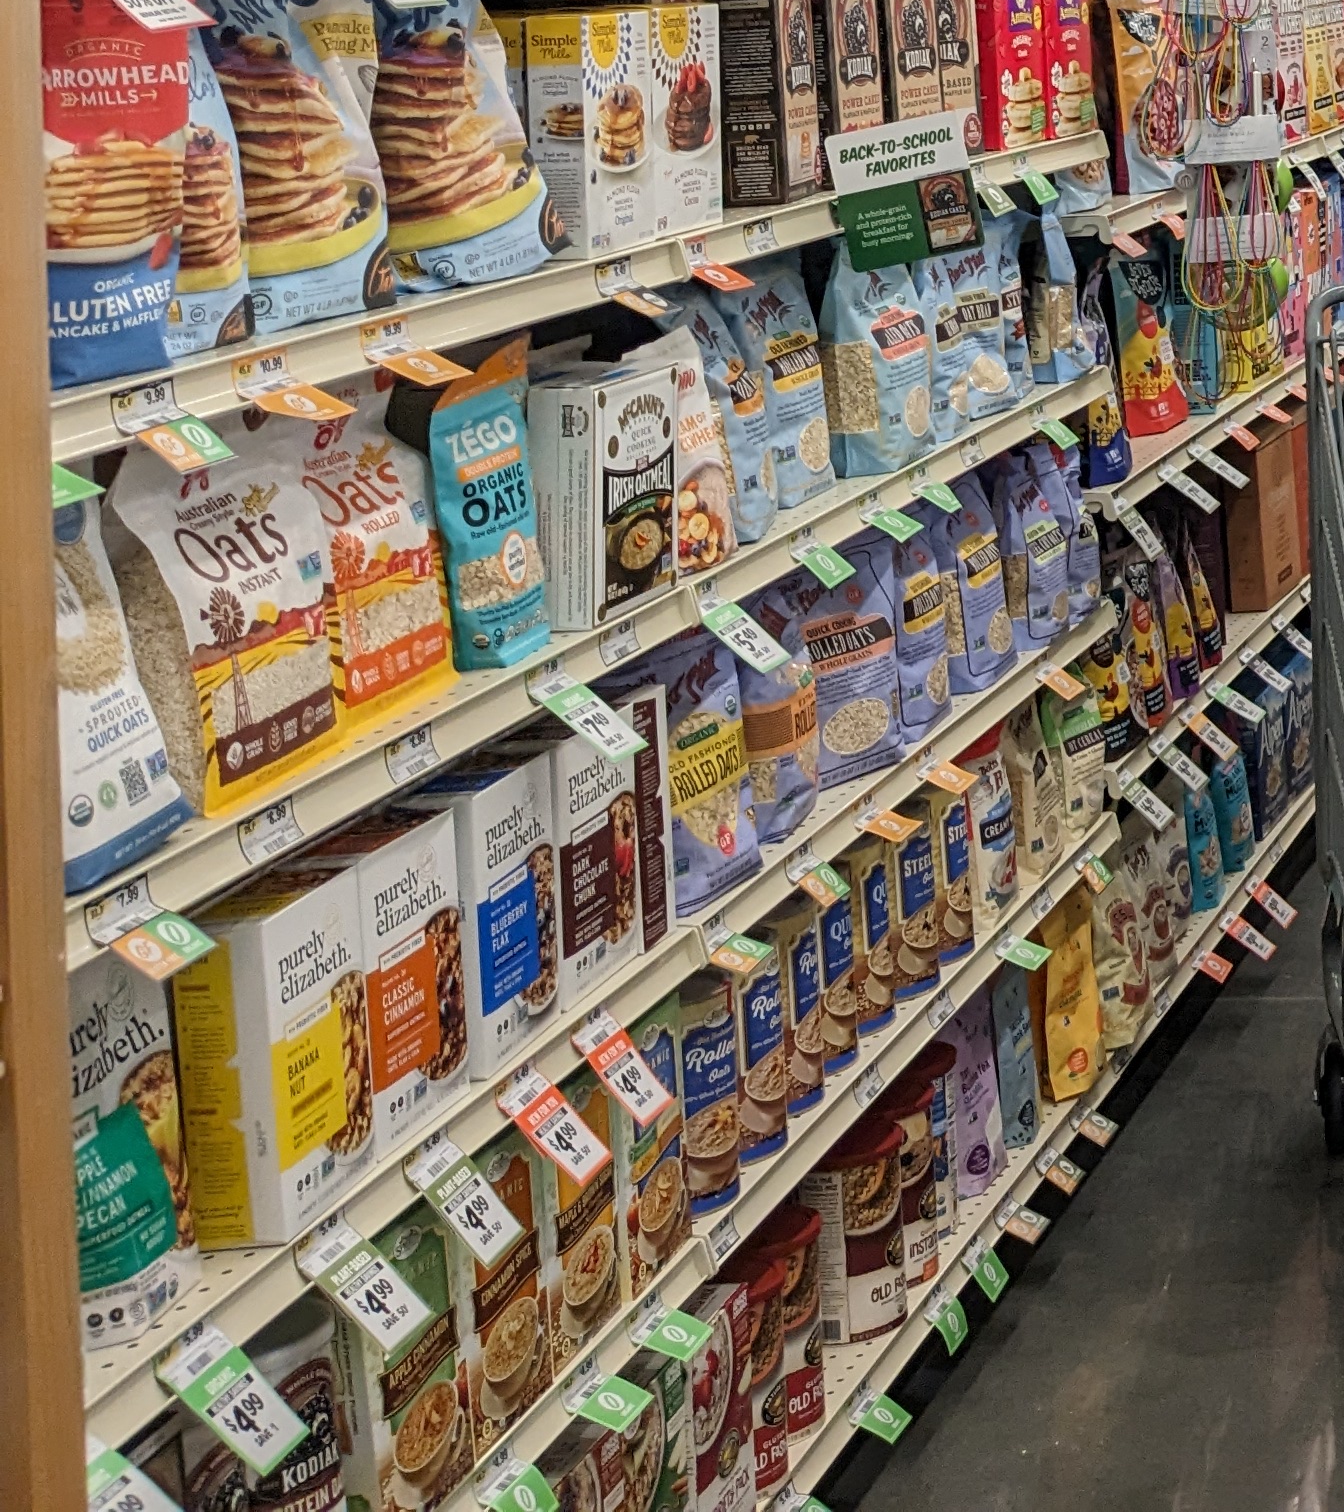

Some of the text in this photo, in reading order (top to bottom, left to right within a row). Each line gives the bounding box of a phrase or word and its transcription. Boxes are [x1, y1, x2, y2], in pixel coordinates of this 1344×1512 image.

[66, 41, 144, 59] ORGANIC
[531, 34, 578, 47] Simple
[540, 48, 572, 59] Mills
[847, 56, 873, 80] KODIAK
[905, 48, 932, 72] KODIAK
[41, 61, 189, 93] ARROWHEAD
[81, 89, 139, 107] MILLS
[839, 126, 954, 164] BACK-TO-SCHOOL
[866, 150, 936, 177] FAVORITES
[856, 213, 912, 230] and protein-rich
[857, 204, 907, 220] A whole-grain
[863, 223, 908, 239] breakfast for
[880, 231, 914, 245] mornings
[54, 279, 172, 323] LUTEN FREE
[50, 323, 109, 339] ANCAKE
[112, 321, 120, 333] &
[445, 414, 517, 464] ZÉGO
[626, 435, 656, 453] COOKING
[303, 450, 351, 472] Australian
[302, 461, 404, 527] Oats
[462, 462, 524, 499] ORGANIC
[609, 453, 672, 515] IRISH OATMEAL
[175, 491, 237, 523] Australian
[462, 479, 526, 527] OATS
[360, 511, 400, 535] ROLLED
[174, 513, 289, 583] Oats
[238, 567, 282, 594] INSTANT
[807, 616, 857, 638] QUICK COOKING
[847, 625, 876, 650] OATS
[818, 657, 847, 671] WHOLE
[85, 695, 140, 733] SPROUTED
[87, 708, 149, 754] QUICK OATS
[568, 755, 606, 797] purely
[669, 760, 685, 774] OLD
[673, 745, 738, 802] ROLLED OATS
[569, 767, 626, 815] elizabeth.
[485, 805, 524, 851] purely
[487, 817, 545, 869] elizabeth.
[572, 857, 590, 878] DARK
[573, 857, 609, 892] CHOCOLATE
[374, 867, 419, 918] purely
[376, 879, 447, 937] elizabeth.
[574, 883, 596, 907] CHUNK
[490, 900, 527, 936] BLUEBERRY
[278, 929, 325, 984] purely
[492, 931, 509, 953] FLAX
[281, 940, 352, 1004] elizabeth.
[382, 977, 415, 1008] CLASSIC
[384, 989, 425, 1026] CINNAMON
[288, 1046, 320, 1080] BANANA
[289, 1078, 305, 1098] NUT
[436, 1166, 472, 1200] PLANT-BASED
[479, 1230, 496, 1246] SAVE
[330, 1250, 373, 1287] PLANT-BASED
[515, 1241, 532, 1269] SPICE
[382, 1311, 400, 1331] SAVE
[389, 1353, 413, 1386] APPLE
[282, 1441, 340, 1493] KODIAK
